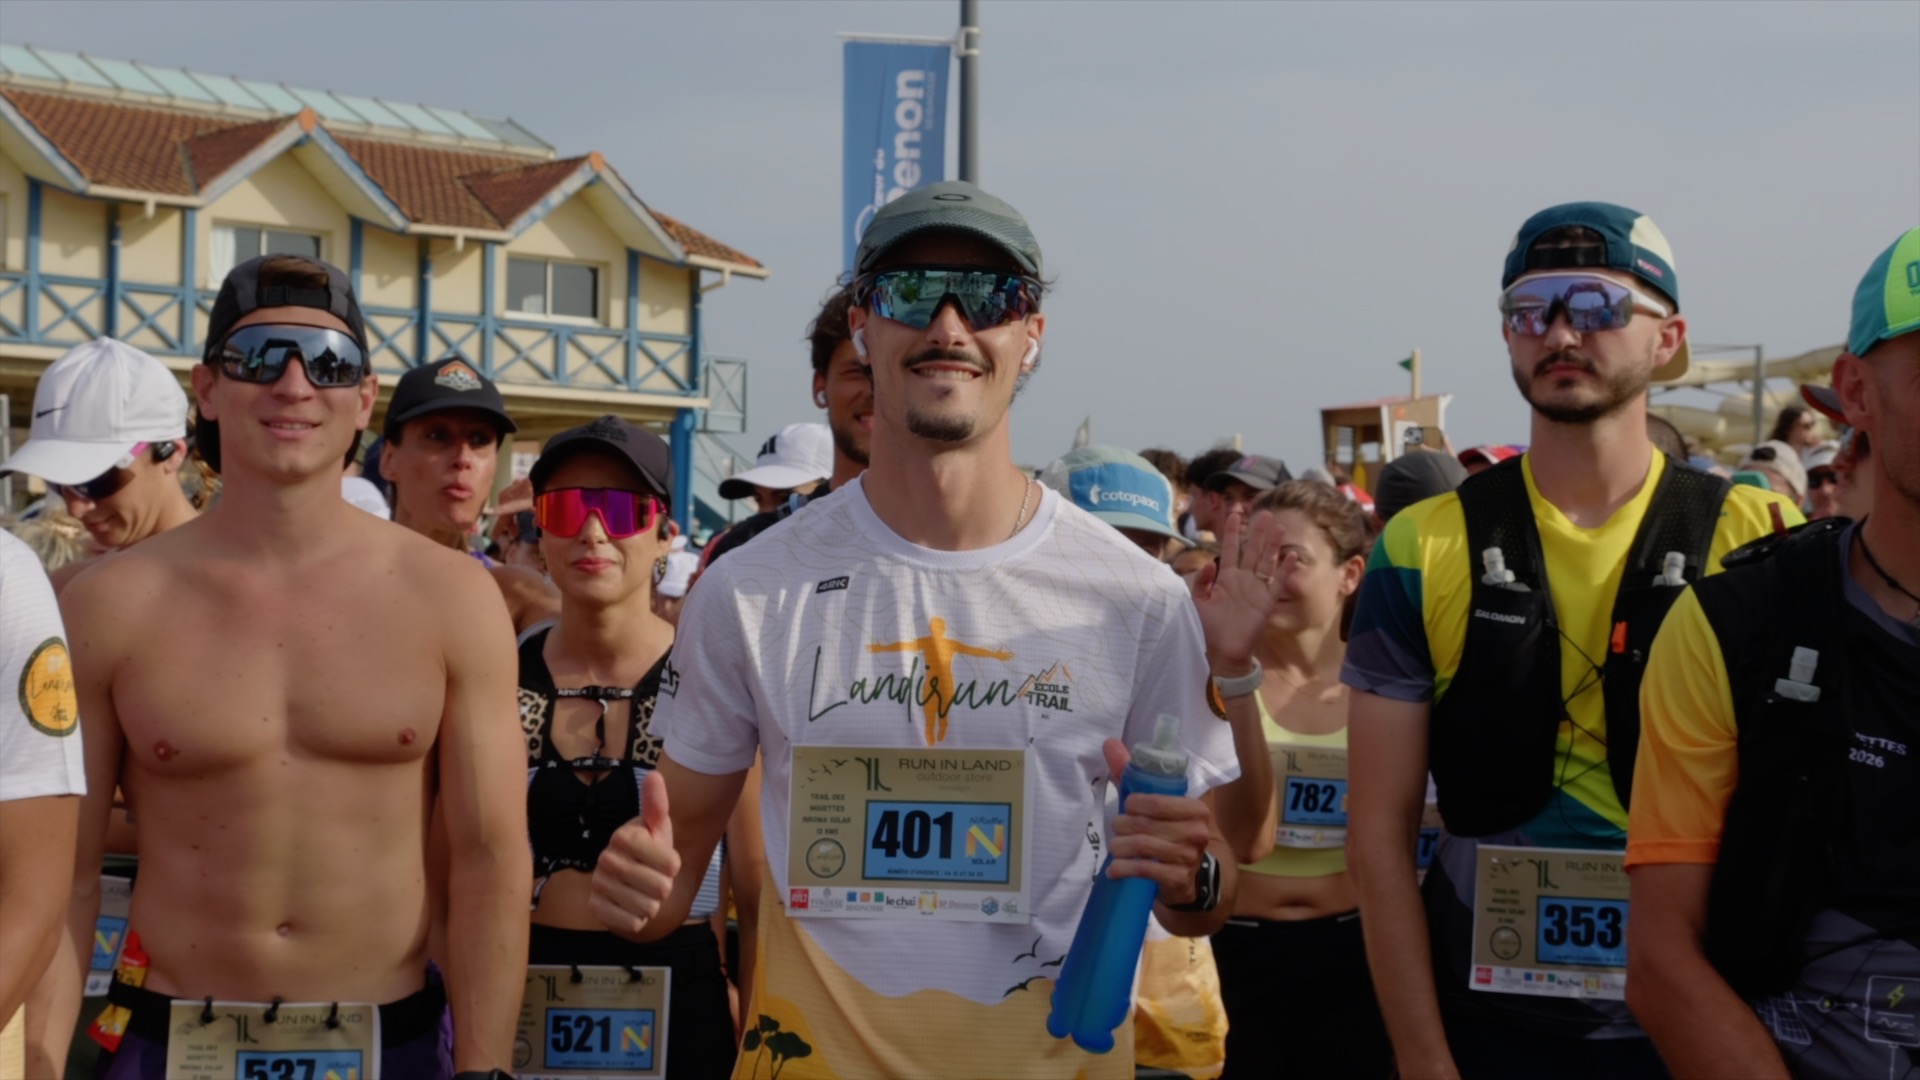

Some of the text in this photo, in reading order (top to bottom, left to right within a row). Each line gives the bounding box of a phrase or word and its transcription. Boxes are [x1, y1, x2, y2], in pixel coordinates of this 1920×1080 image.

[1101, 490, 1160, 512] cotopaxi
[1474, 608, 1526, 625] SALOMON
[808, 646, 1018, 723] Landirun
[1034, 683, 1070, 695] ECOLE
[1024, 690, 1074, 713] TRAIL
[1855, 731, 1909, 756] ETTES
[898, 758, 1012, 772] RUN IN LAND
[1849, 747, 1885, 768] 2026
[917, 771, 993, 783] outdoor store
[810, 792, 830, 801] TRAIL
[1289, 781, 1338, 815] 782
[872, 809, 954, 860] 401
[971, 858, 997, 867] SOLAR
[1565, 860, 1617, 874] RUN IN
[885, 896, 916, 906] le chai
[1543, 903, 1623, 950] 353
[618, 976, 656, 987] LND
[300, 1013, 316, 1026] IN
[320, 1012, 363, 1025] LND
[551, 1014, 611, 1054] 521
